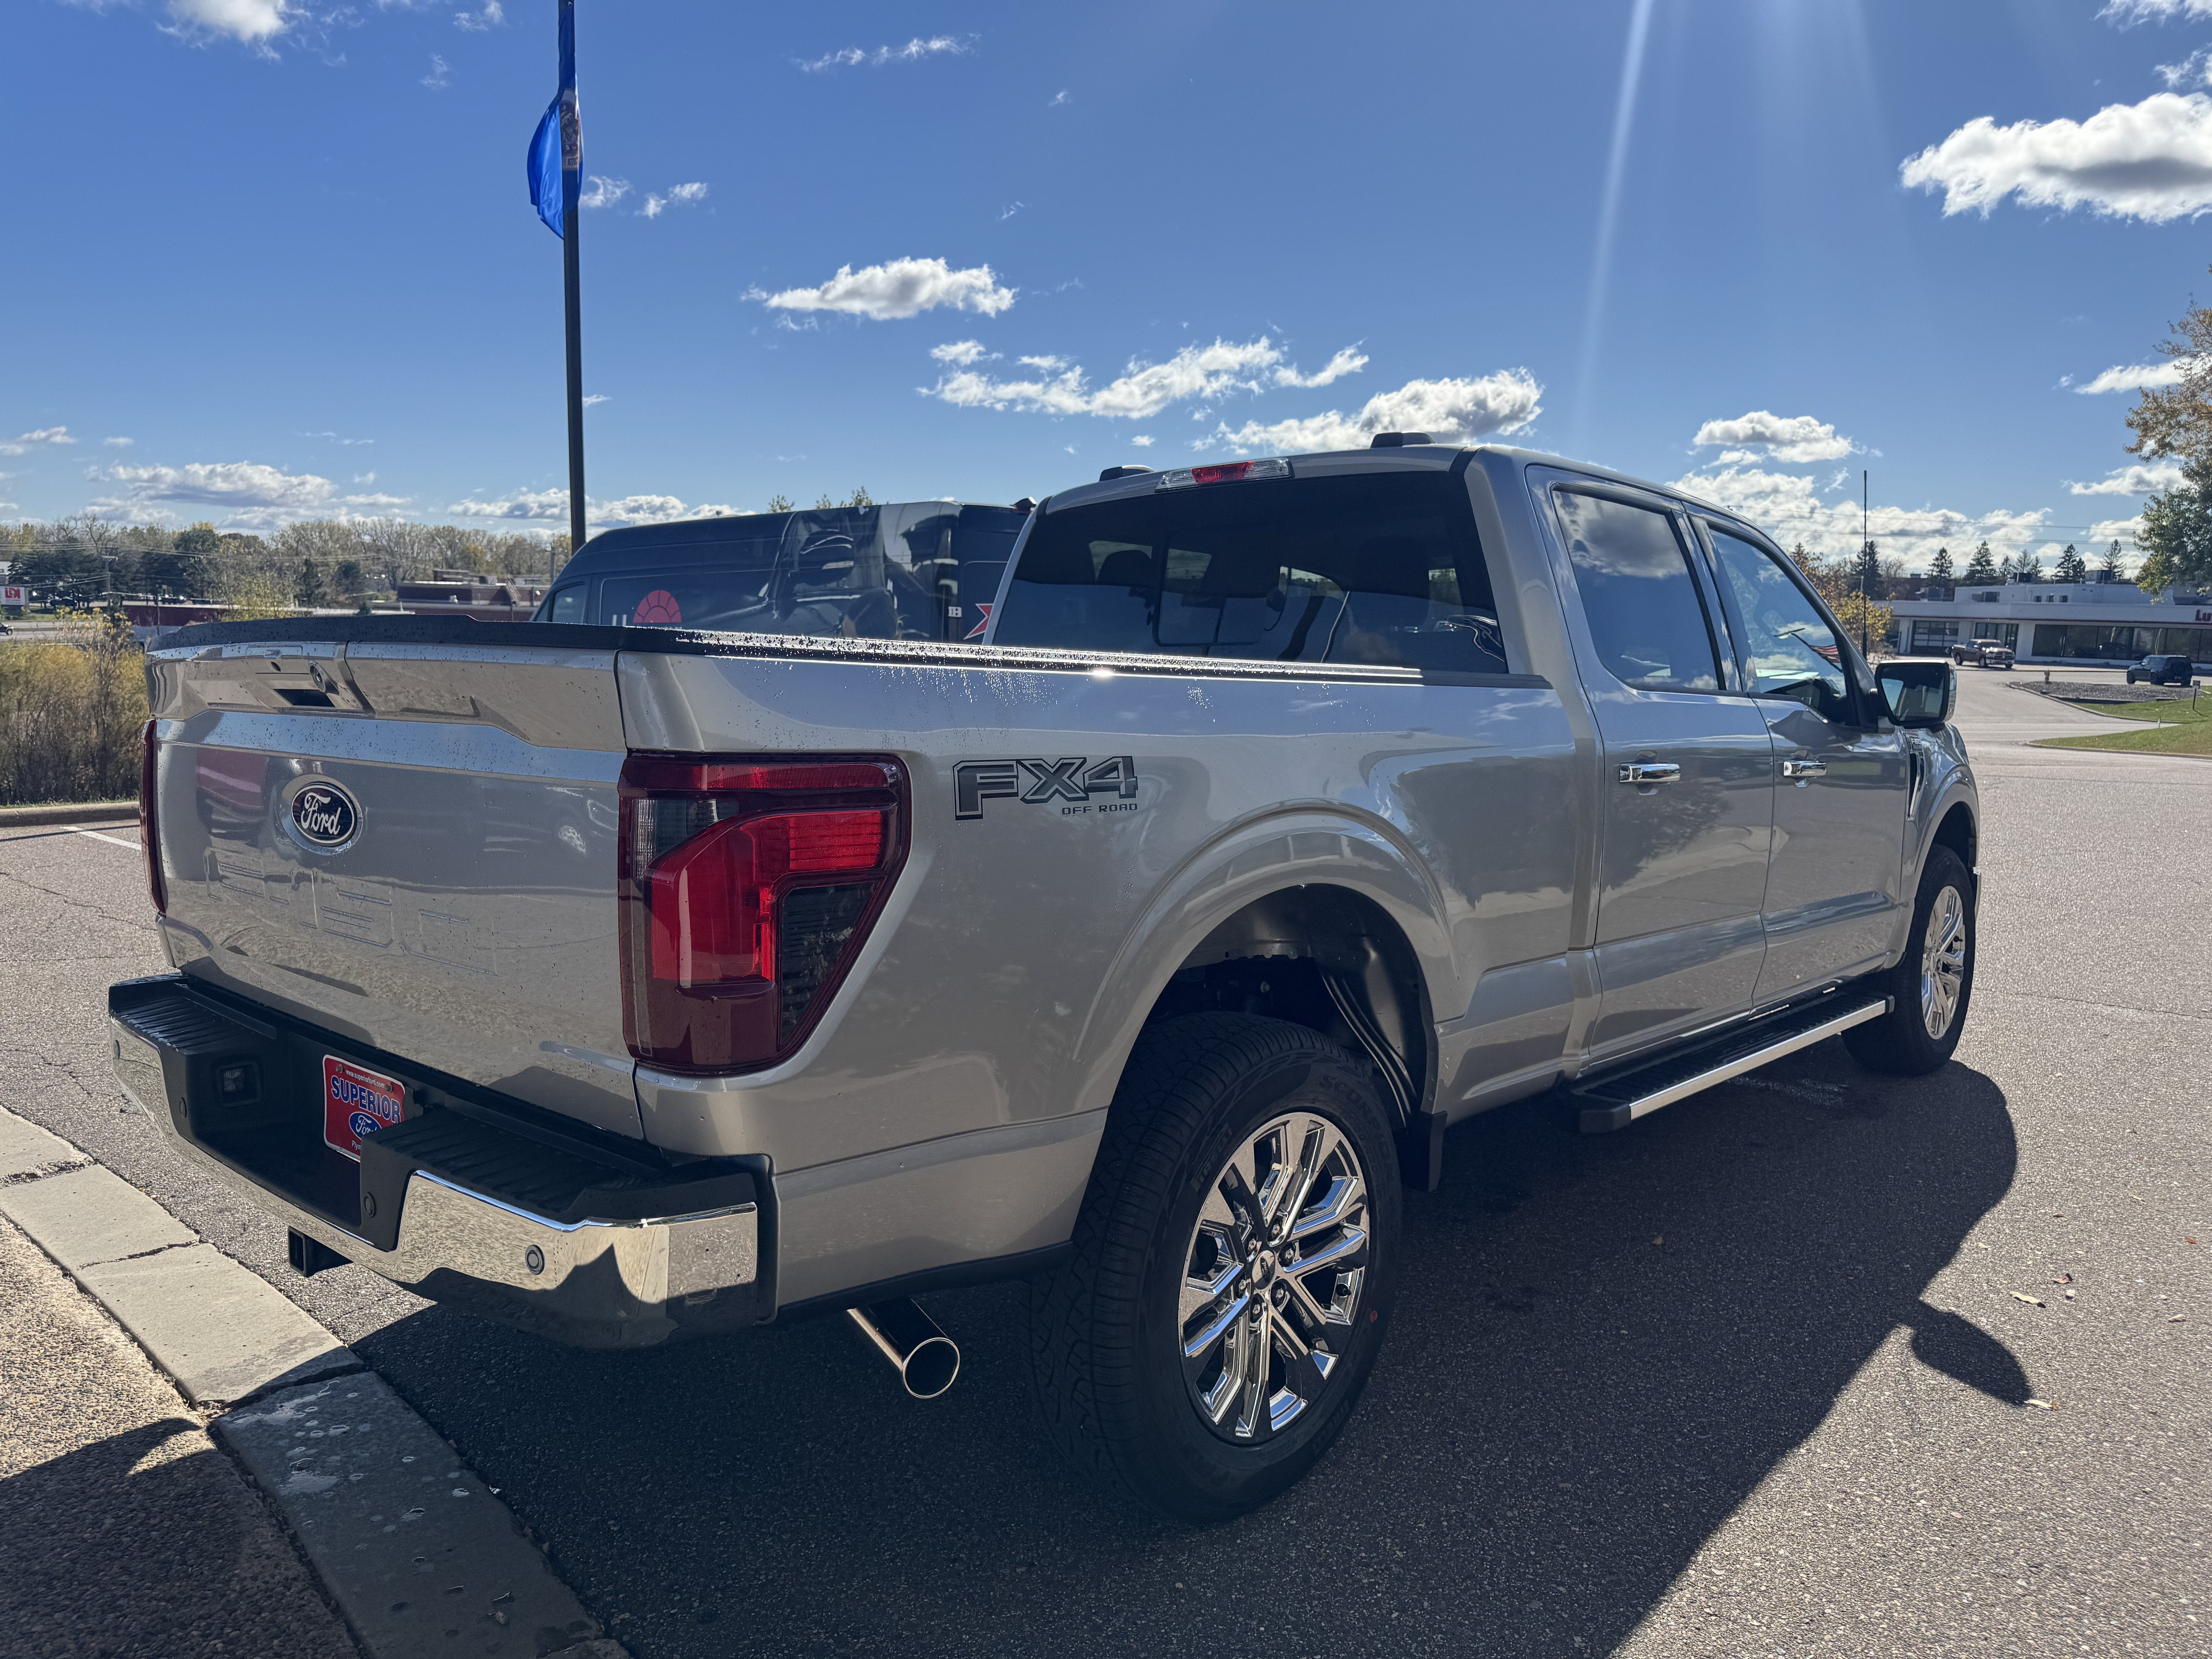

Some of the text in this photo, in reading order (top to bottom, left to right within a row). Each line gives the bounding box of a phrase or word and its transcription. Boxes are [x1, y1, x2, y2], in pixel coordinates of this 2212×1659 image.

[2195, 609, 2212, 622] Lu
[952, 756, 1139, 821] FX4
[301, 792, 341, 835] Ford
[1061, 803, 1138, 815] OFF ROAD
[345, 1070, 385, 1089] www.superiorford.com
[331, 1075, 401, 1123] SUPERIOR
[352, 1140, 361, 1150] Plym
